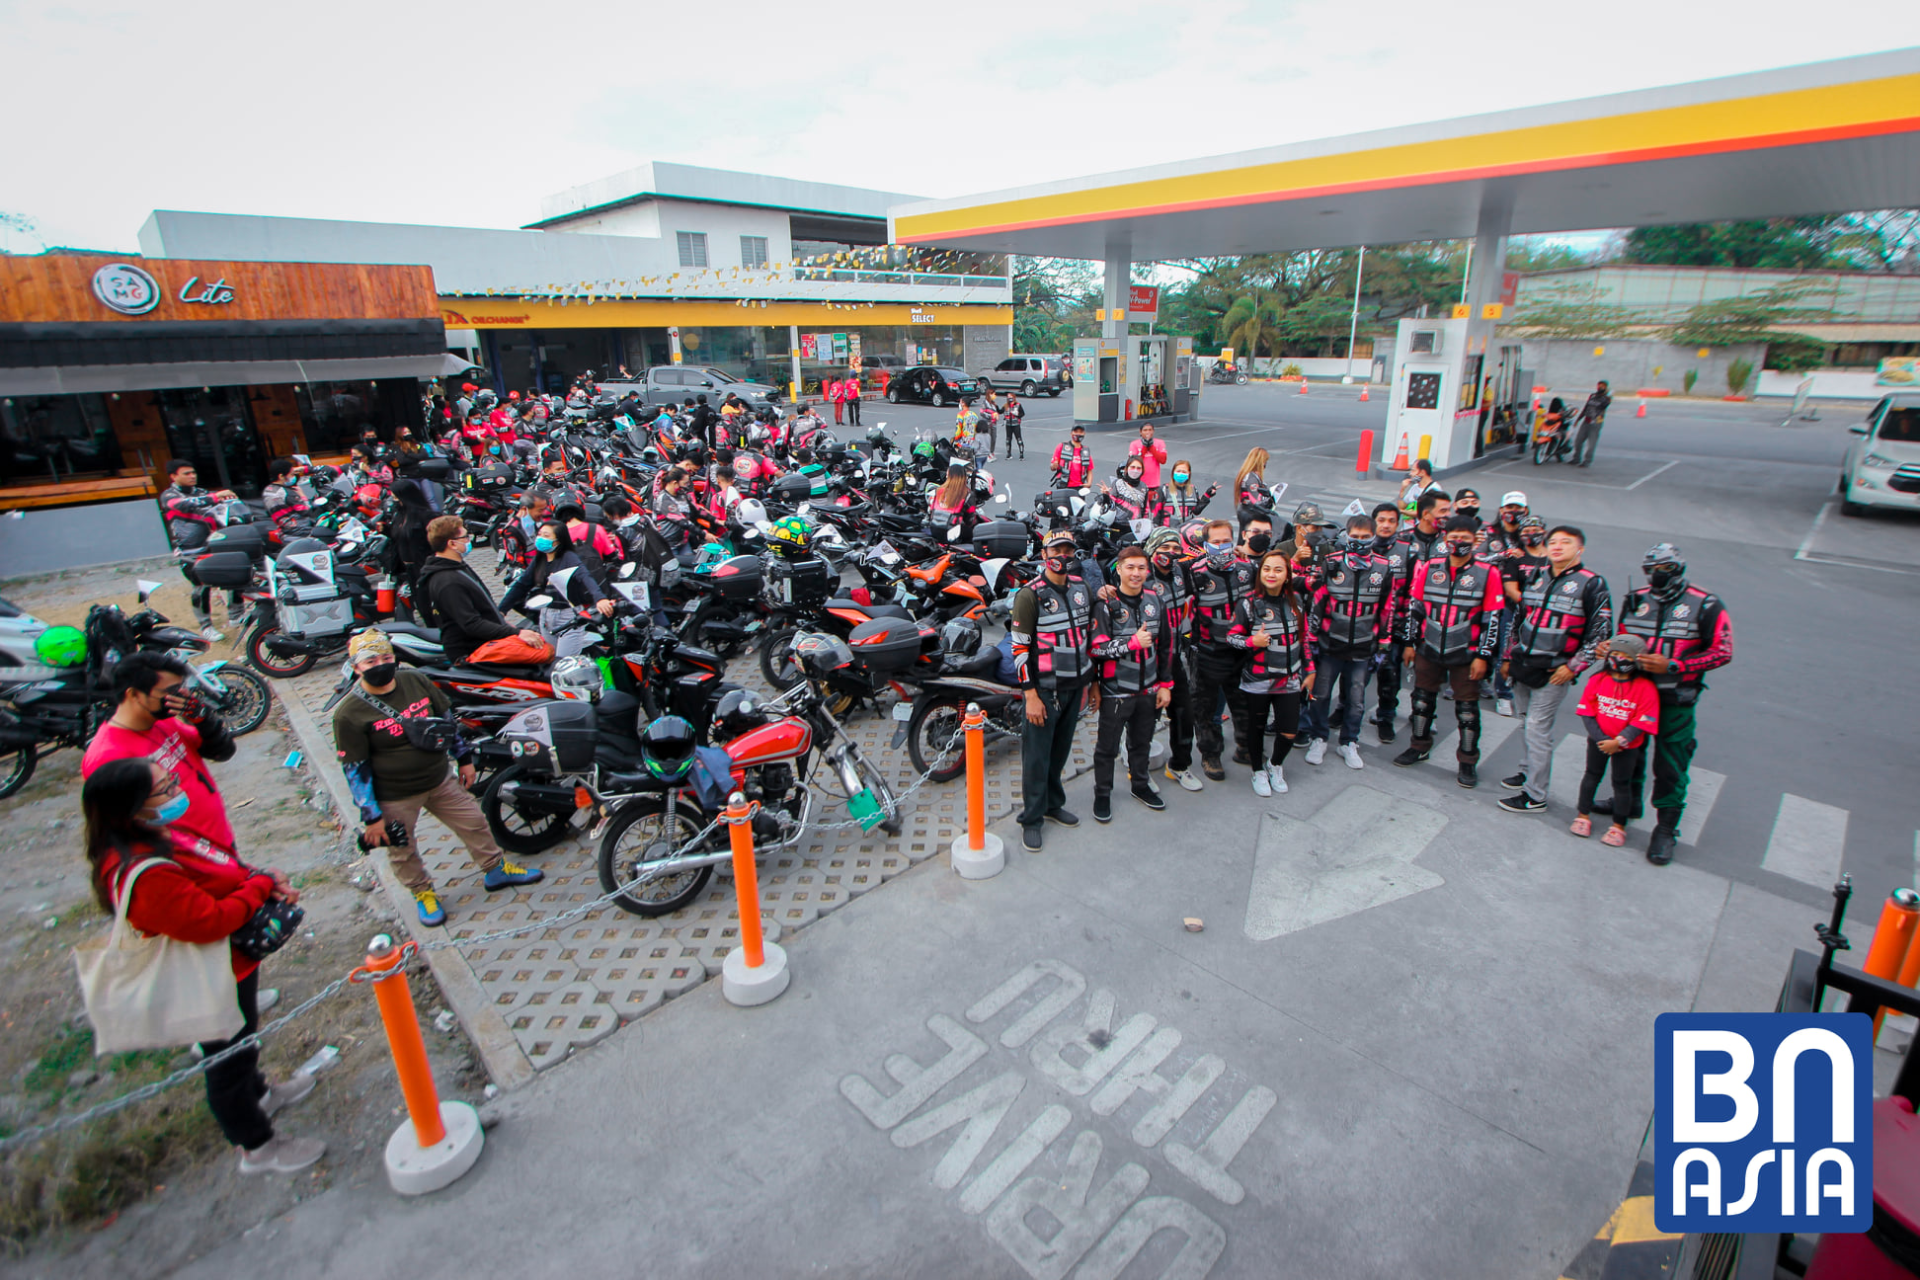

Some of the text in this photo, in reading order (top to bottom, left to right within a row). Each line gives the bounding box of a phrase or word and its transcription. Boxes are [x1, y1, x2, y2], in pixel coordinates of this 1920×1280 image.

[178, 276, 235, 304] Lite
[911, 314, 935, 323] SELECT
[839, 1012, 1227, 1280] DRIVE
[964, 958, 1278, 1204] THRU
